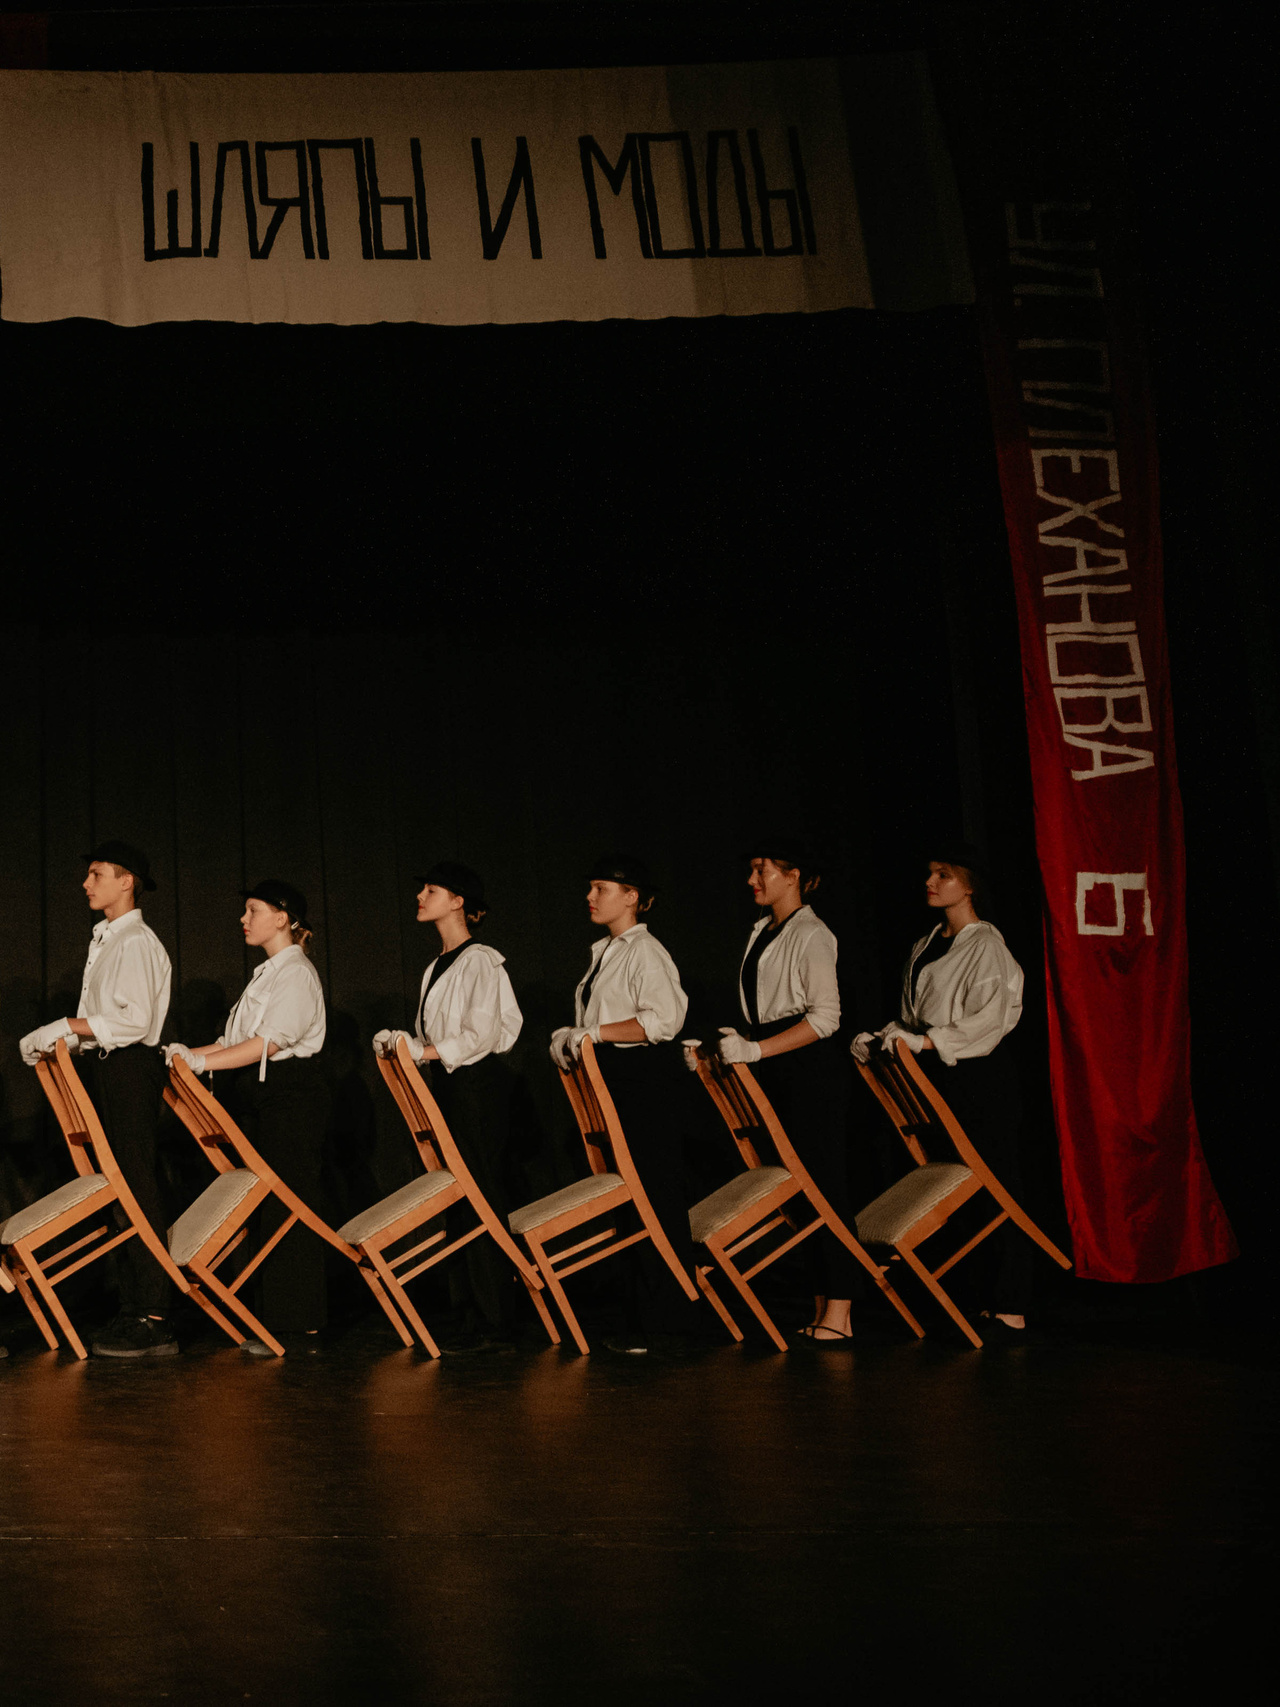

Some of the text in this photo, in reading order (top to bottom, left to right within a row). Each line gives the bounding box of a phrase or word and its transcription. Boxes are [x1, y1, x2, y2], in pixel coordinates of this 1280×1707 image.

[141, 125, 818, 262] ШЛЯПЫ И МОДЫ
[1017, 338, 1155, 782] ПЛЕХАНОВА
